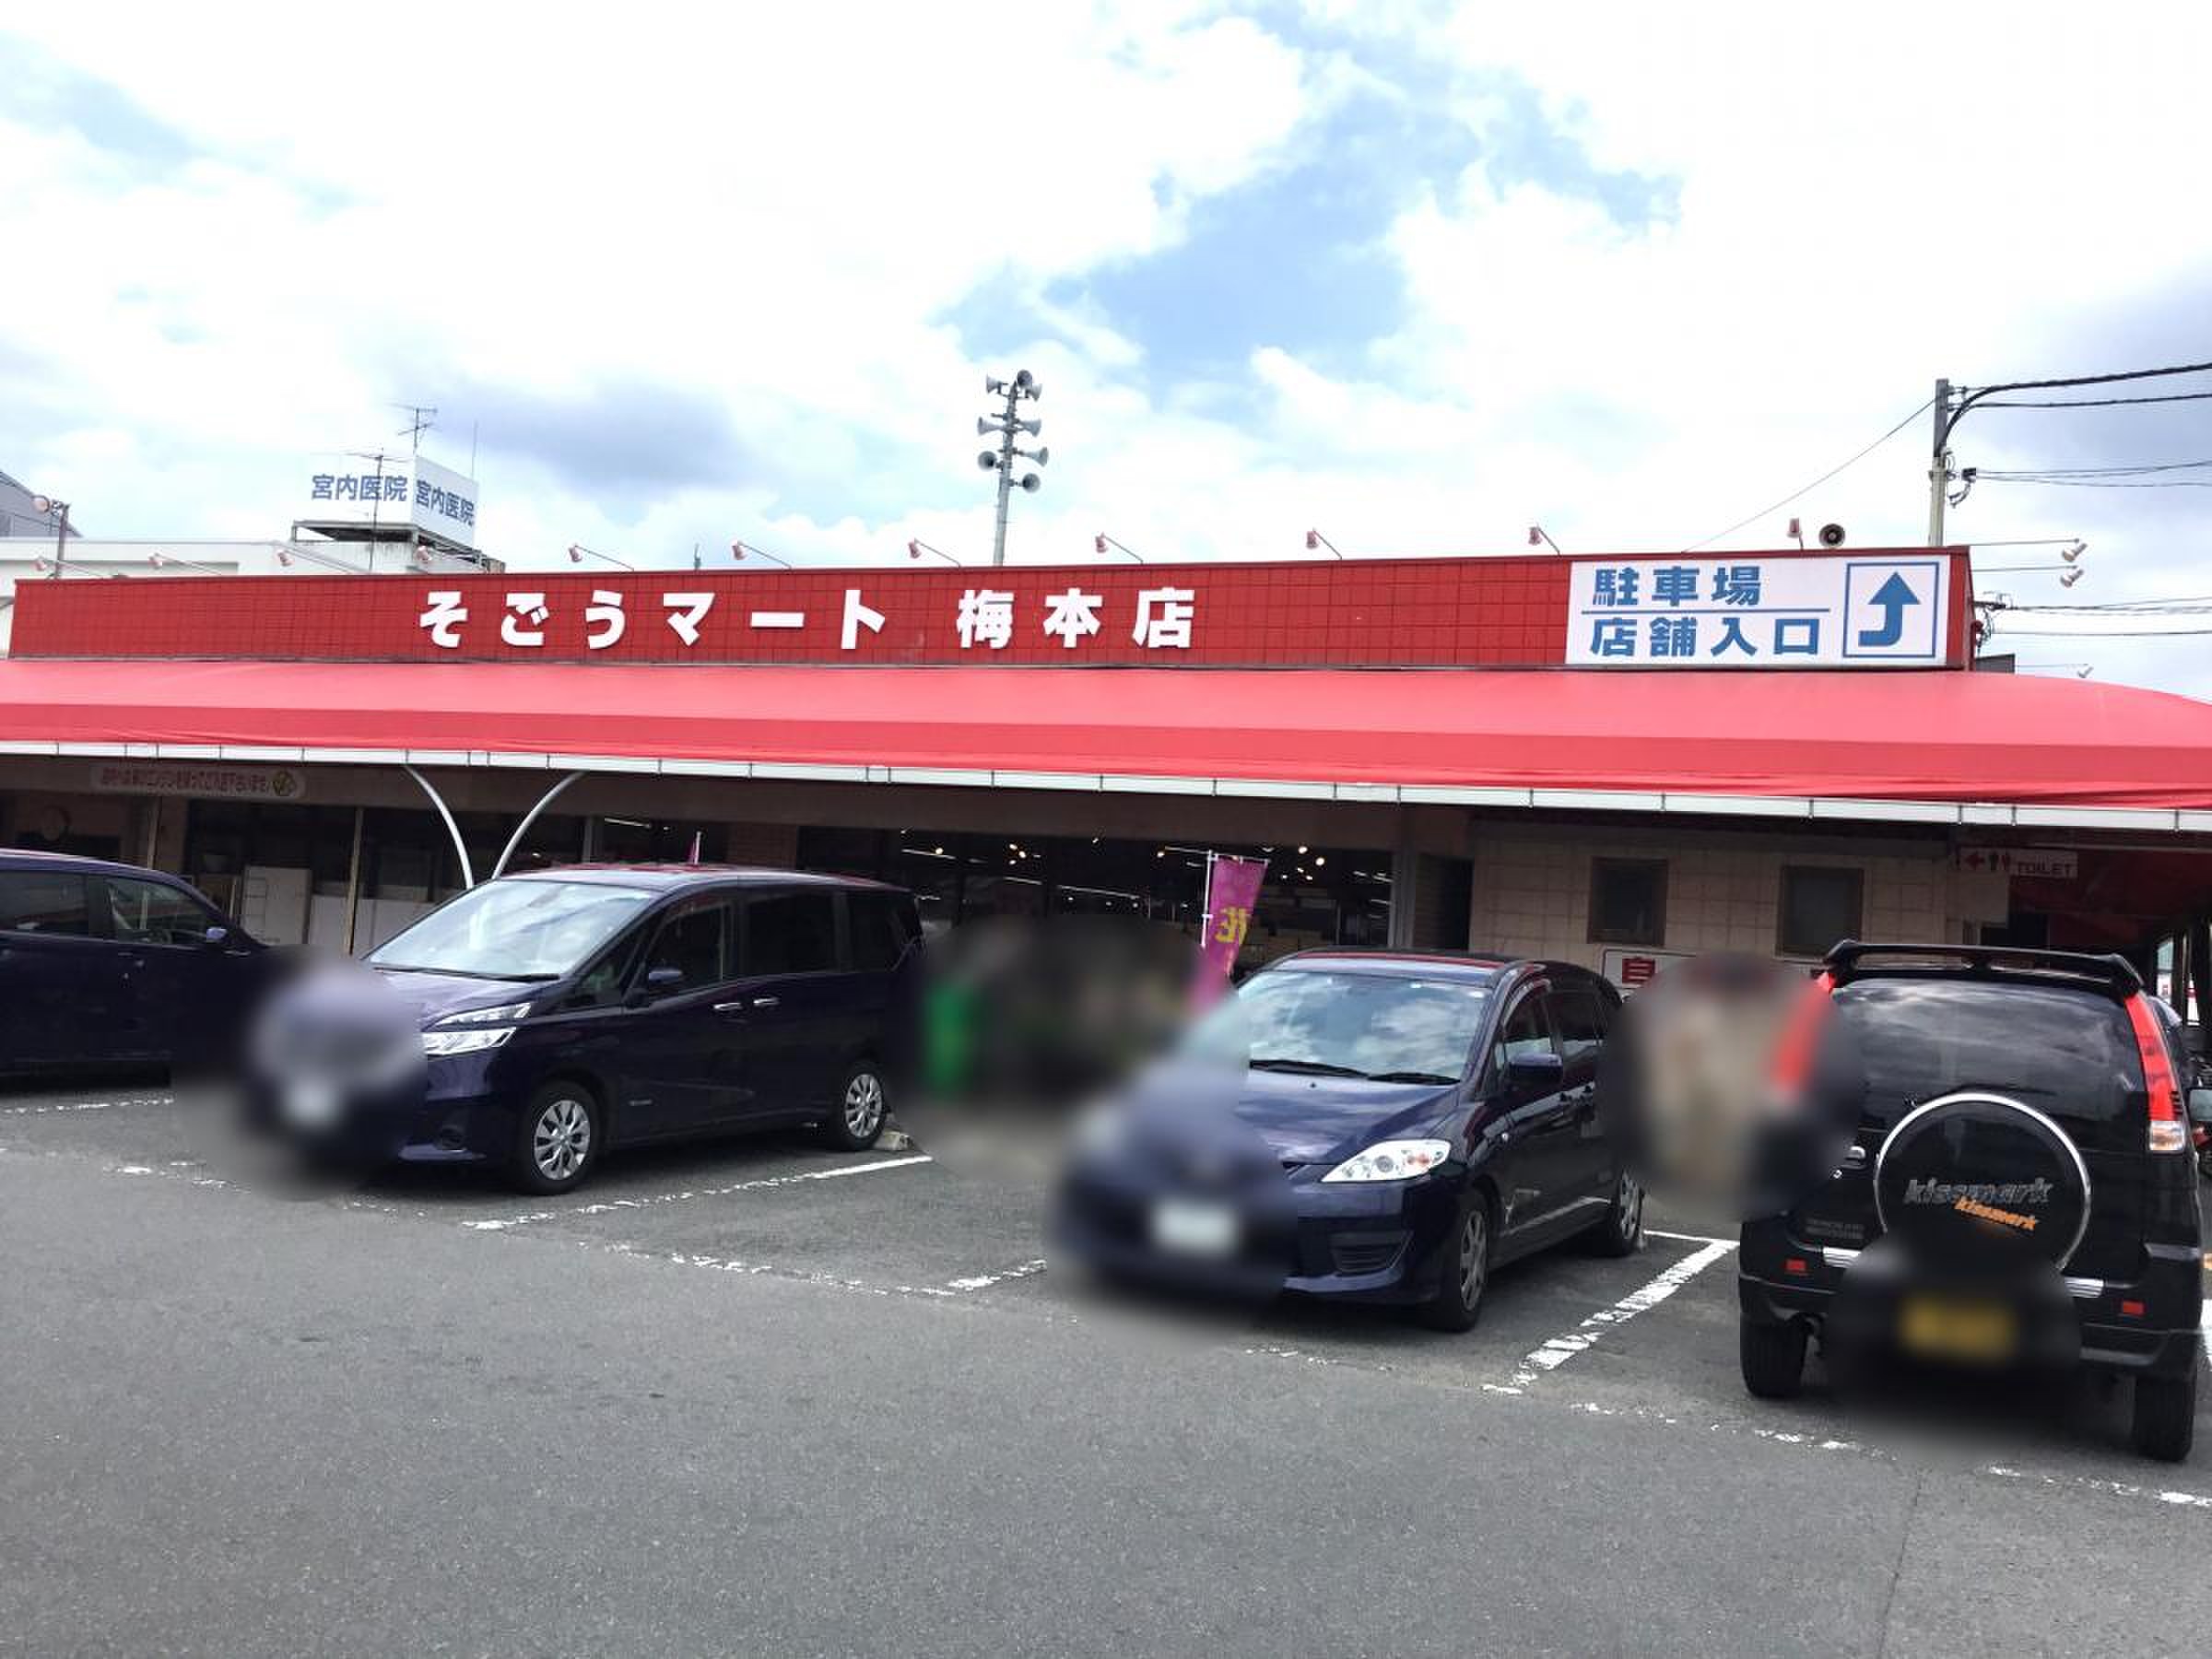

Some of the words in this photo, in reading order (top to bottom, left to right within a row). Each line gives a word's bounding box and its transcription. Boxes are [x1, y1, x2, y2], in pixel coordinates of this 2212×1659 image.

[311, 474, 408, 502] 宮内医院
[415, 479, 475, 526] 宮内医院
[1592, 566, 1761, 606] 駐車場
[419, 589, 886, 650] そごうマート
[956, 586, 1196, 649] 梅本店
[1590, 616, 1820, 657] 店舗入口
[1903, 1176, 2053, 1205] kissmark
